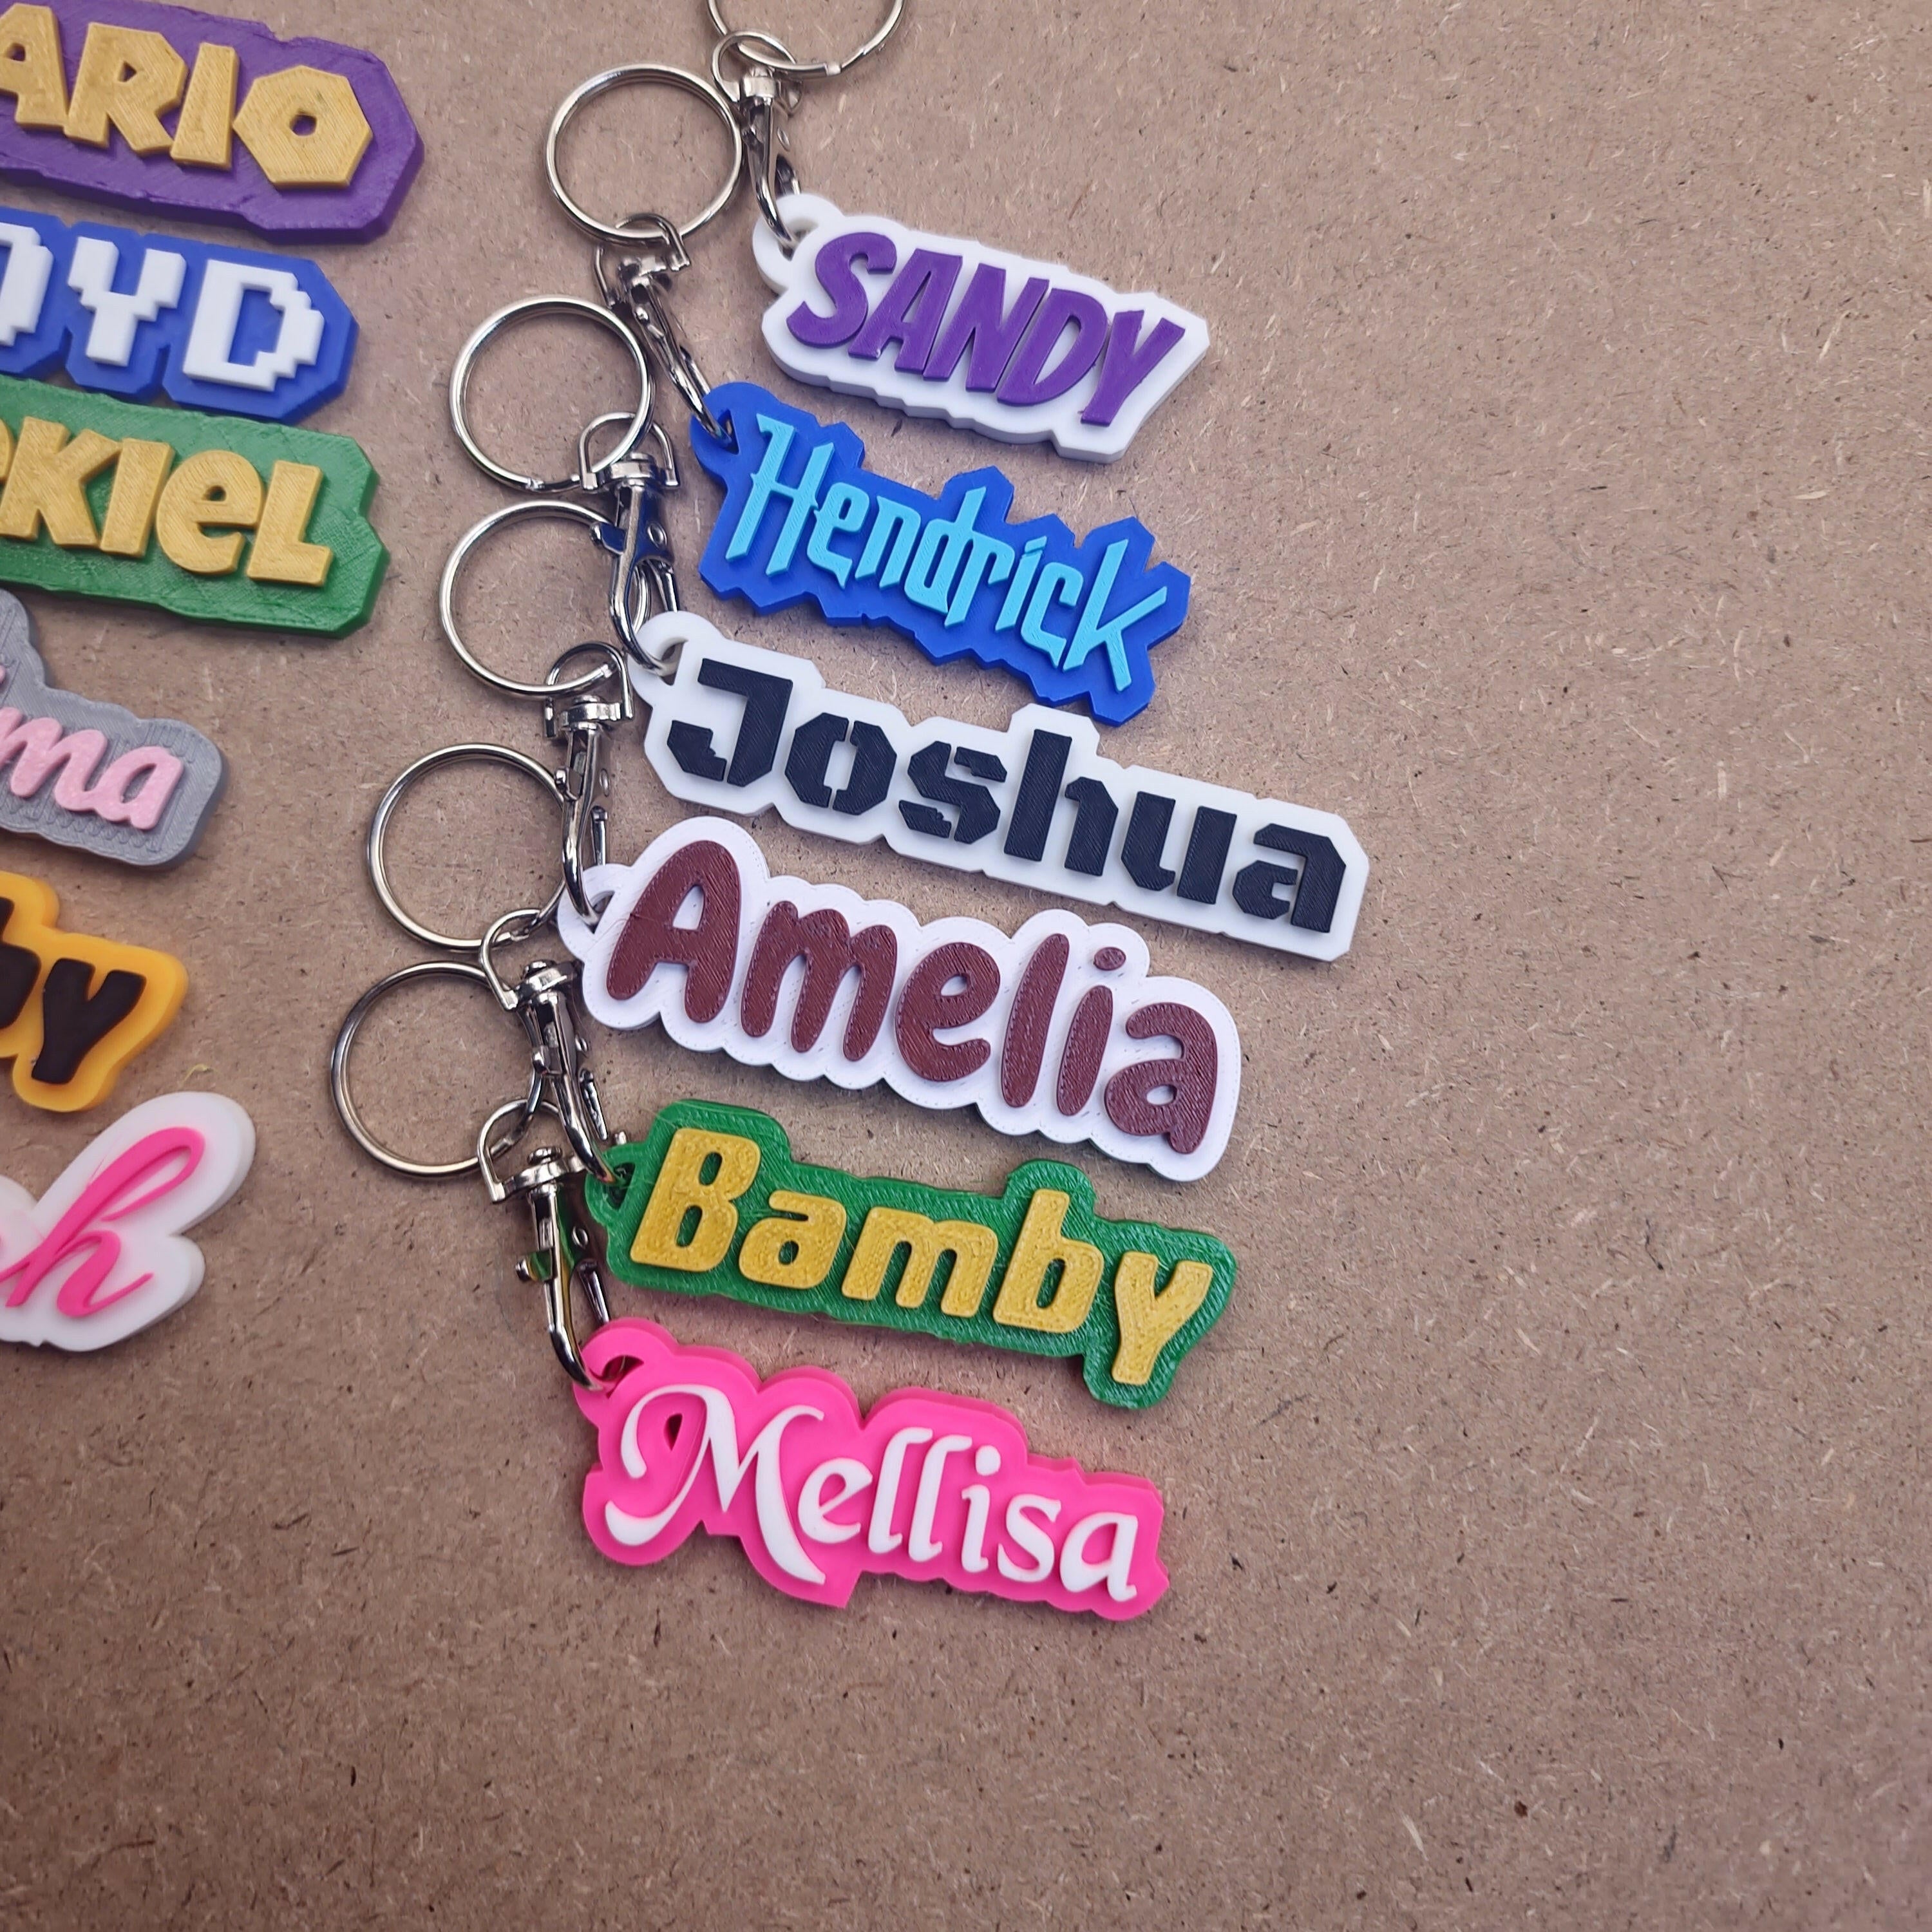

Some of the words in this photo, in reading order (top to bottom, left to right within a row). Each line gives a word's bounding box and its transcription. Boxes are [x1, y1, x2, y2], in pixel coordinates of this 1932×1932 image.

[0, 3, 374, 189] ARIO
[786, 231, 1186, 426] SANDY
[0, 415, 334, 587] KIeL
[725, 413, 1168, 692] Hendrick
[0, 665, 184, 830] ma
[665, 658, 1347, 933] Joshua
[606, 839, 1218, 1155] Amelia
[0, 1126, 206, 1318] h
[630, 1127, 1213, 1385] Bamby
[604, 1383, 1139, 1602] Mellisa
